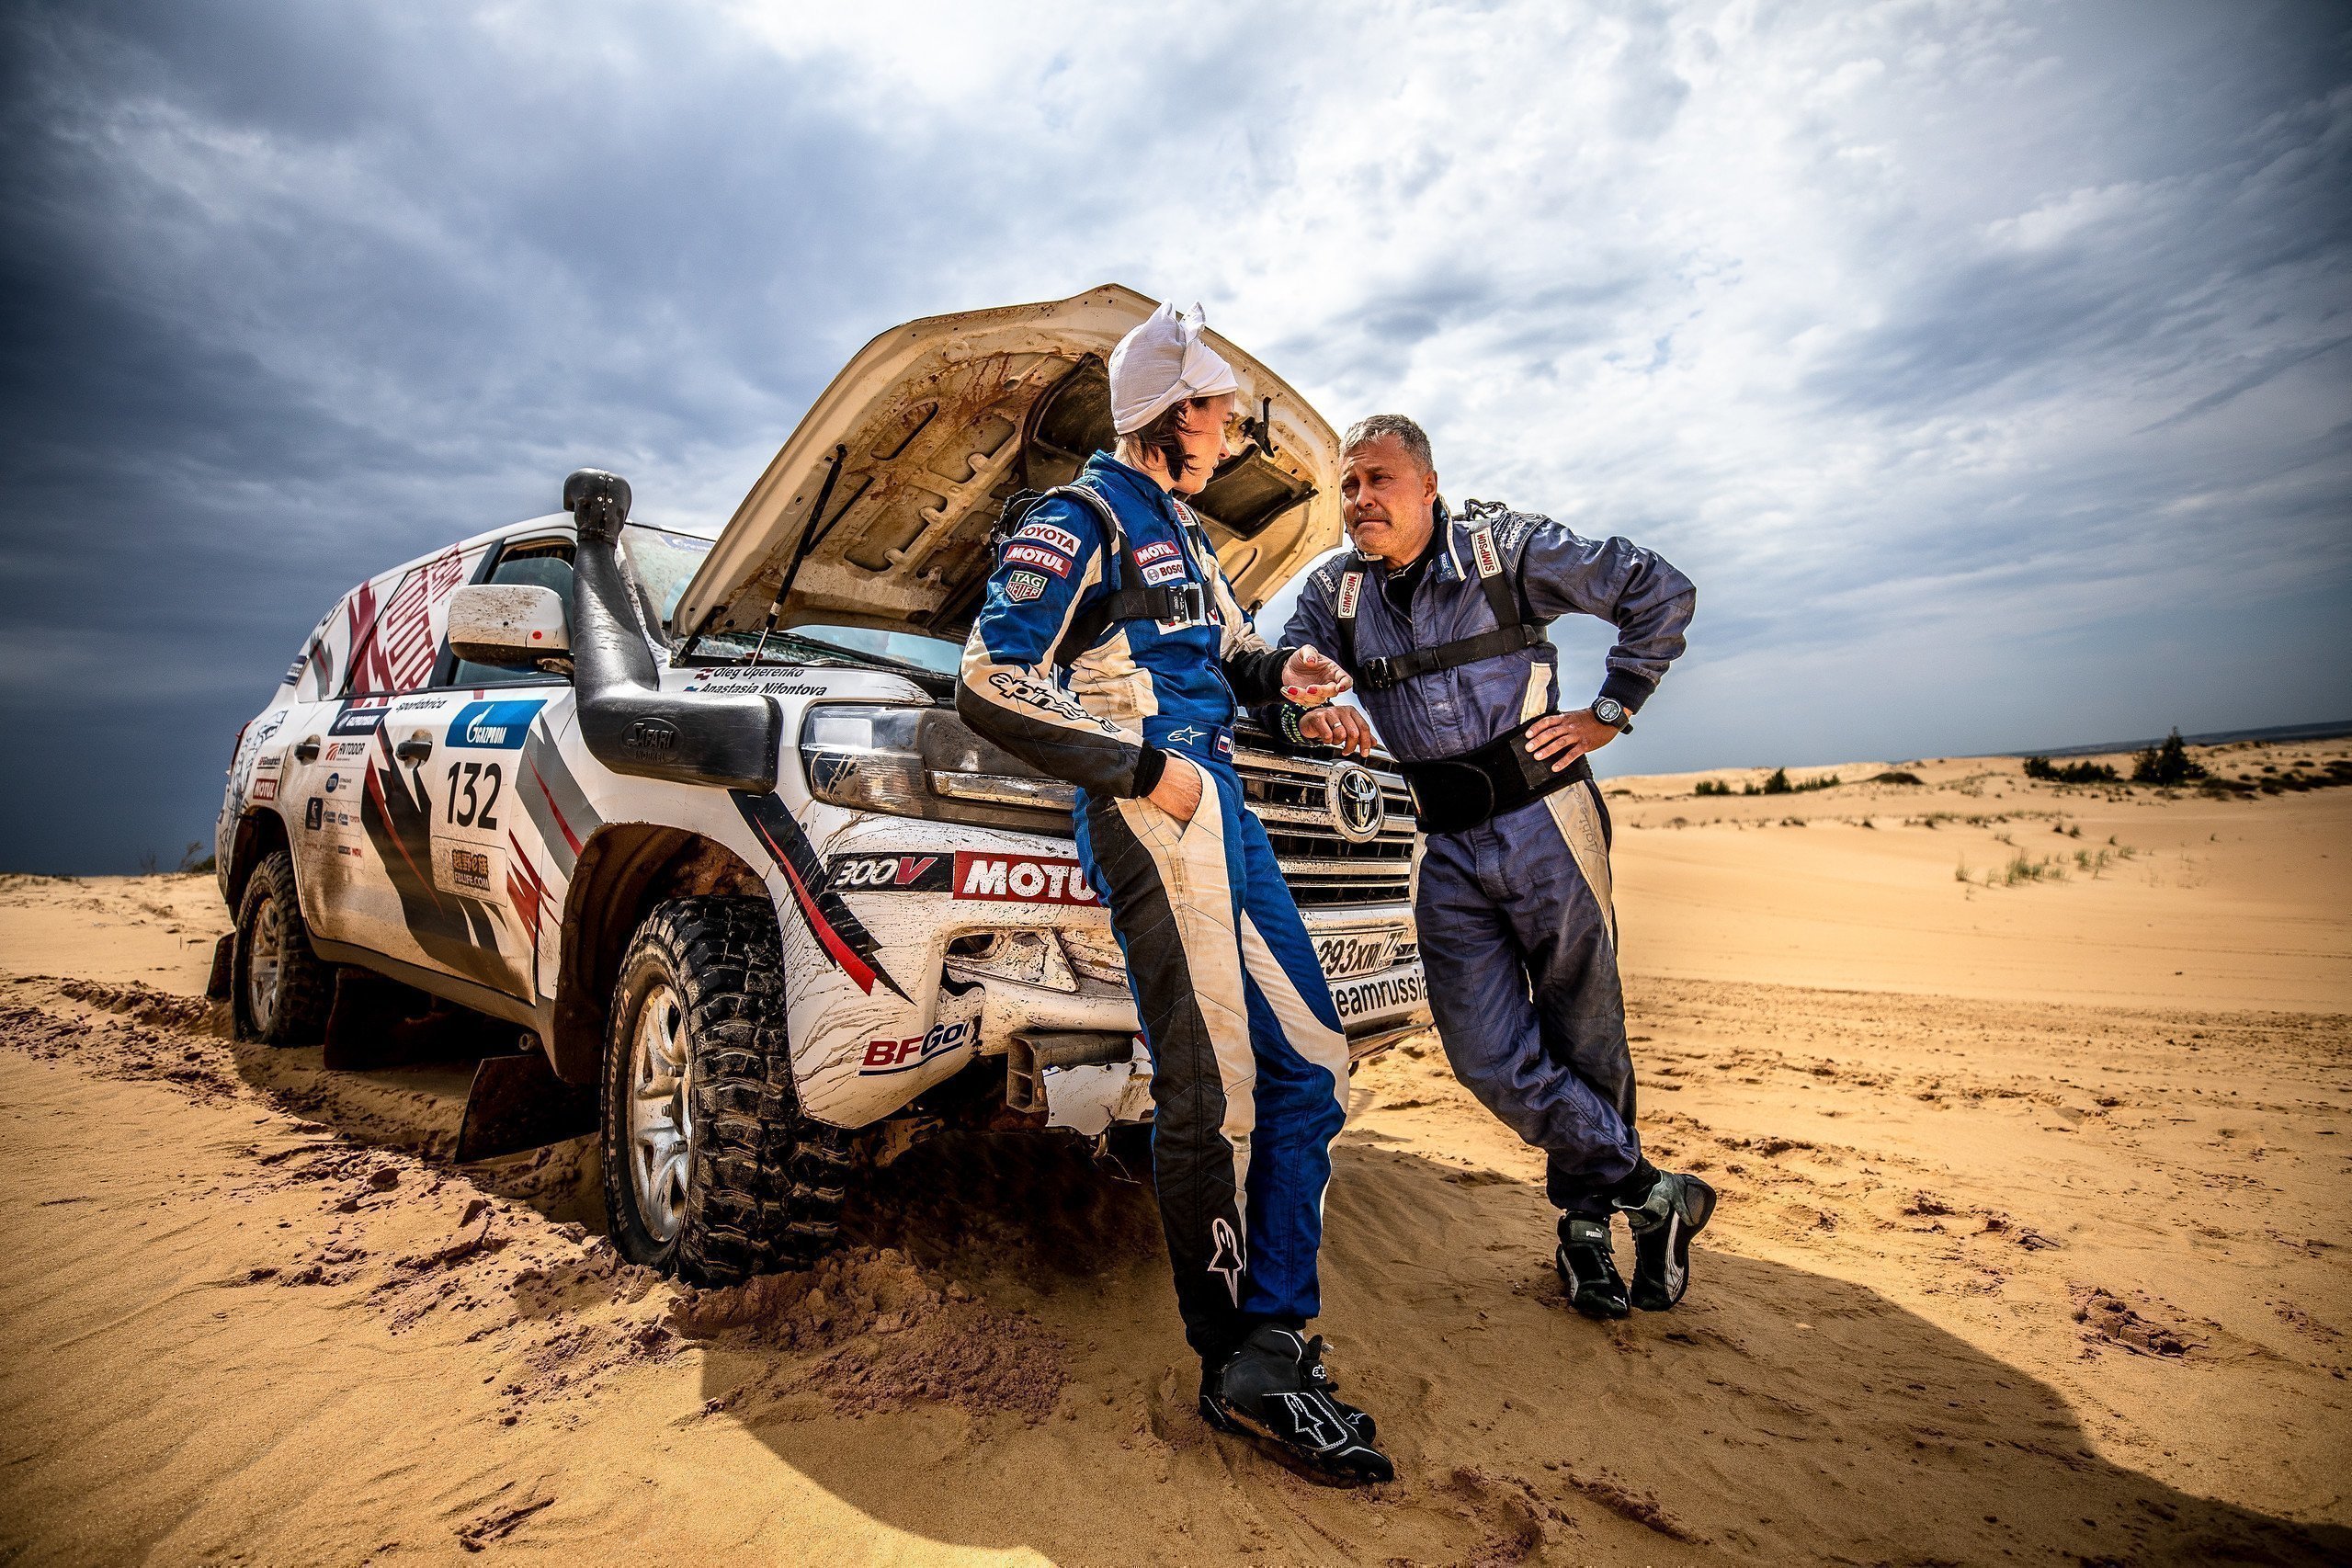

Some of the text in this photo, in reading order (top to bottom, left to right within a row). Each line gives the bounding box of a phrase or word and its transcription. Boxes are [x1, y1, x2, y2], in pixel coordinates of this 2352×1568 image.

[1007, 547, 1064, 572] MOTUL
[1477, 533, 1495, 572] SIMPSON
[1015, 573, 1042, 588] TAG
[1159, 564, 1184, 576] BOSC
[1007, 583, 1039, 599] HEUER
[1342, 574, 1358, 614] SIMPSON
[759, 683, 828, 697] Nifontova
[447, 761, 502, 831] 132
[835, 856, 1097, 902] 300V MOTU
[1331, 968, 1429, 1017] eamrussia
